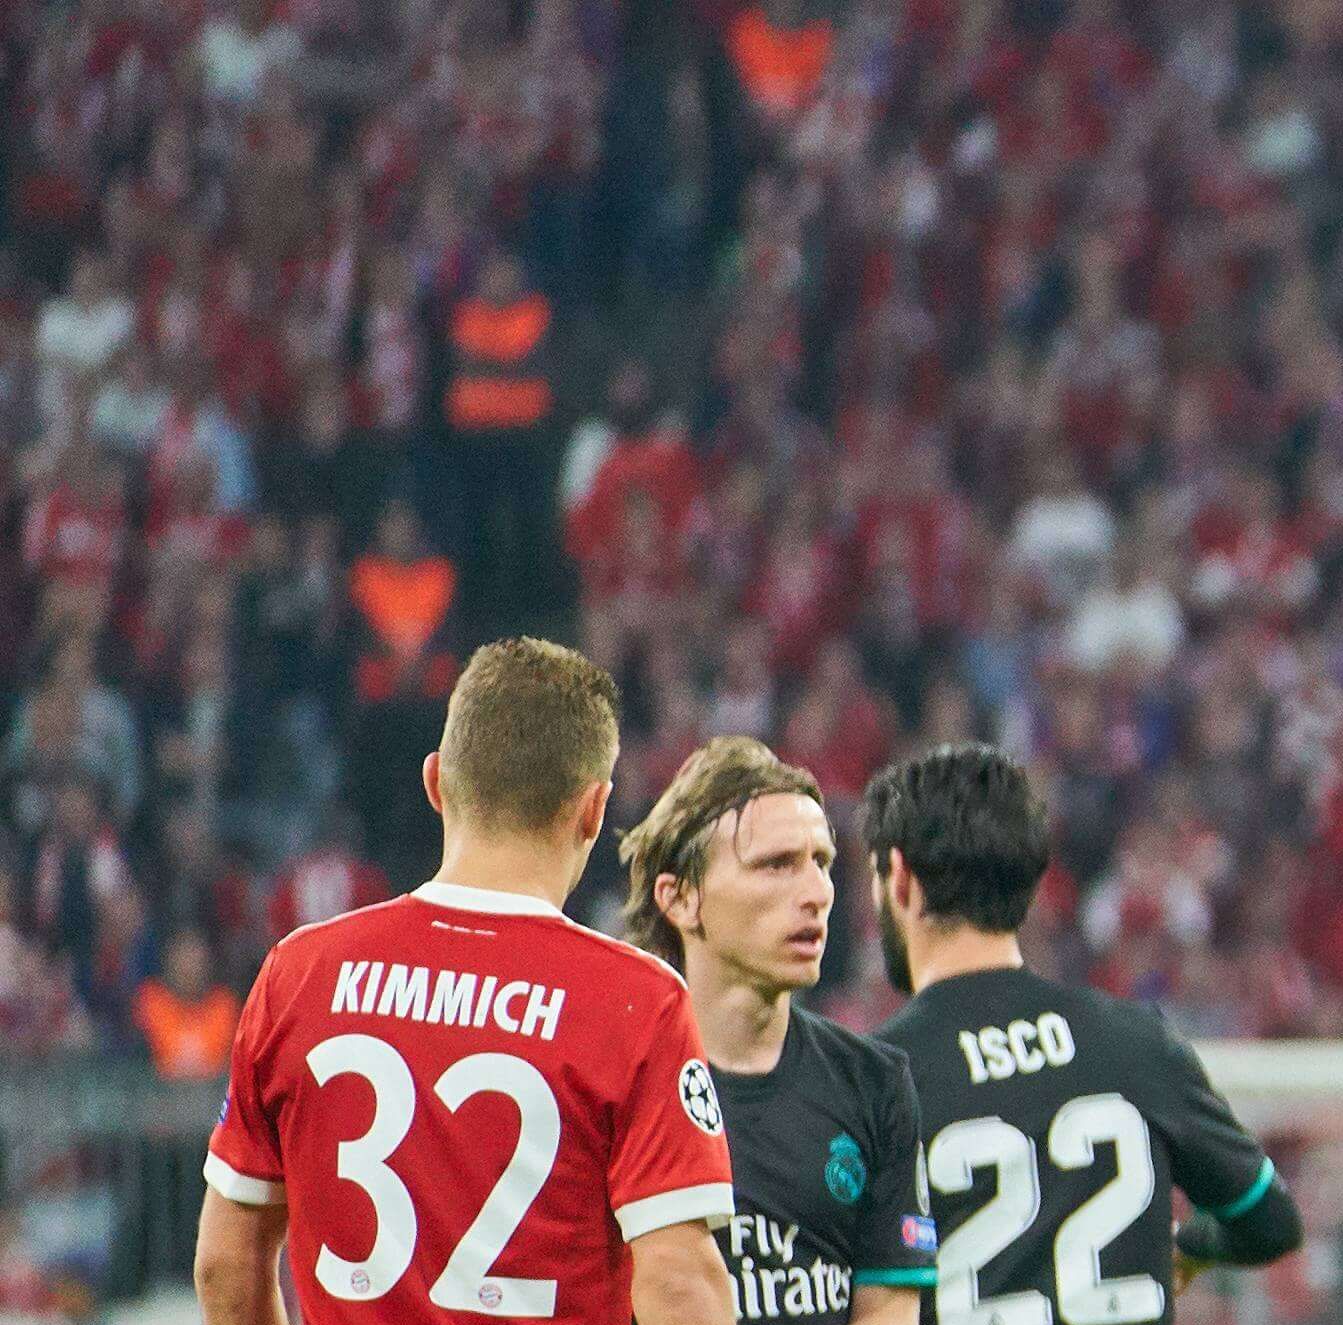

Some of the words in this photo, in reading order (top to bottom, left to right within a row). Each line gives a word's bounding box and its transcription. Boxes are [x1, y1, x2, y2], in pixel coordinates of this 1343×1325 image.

[331, 960, 566, 1041] KIMMICH
[959, 1011, 1076, 1085] ISCO
[305, 1034, 562, 1318] 32
[729, 1214, 799, 1264] Fly
[730, 1256, 853, 1319] irates
